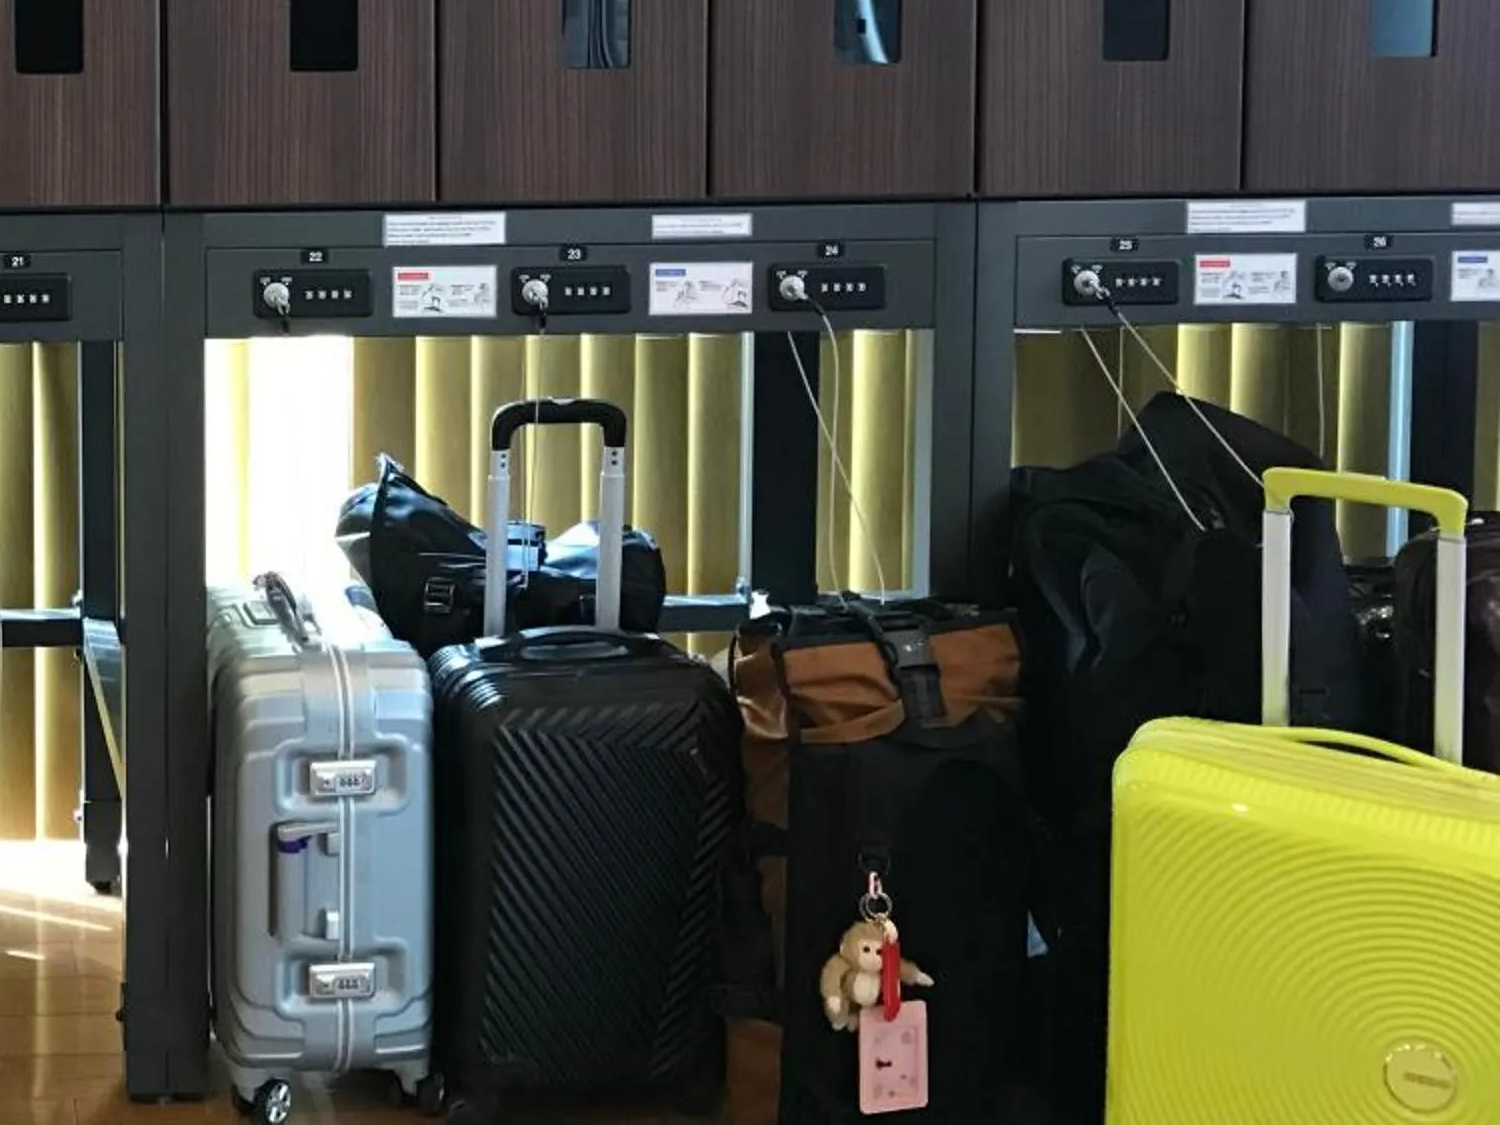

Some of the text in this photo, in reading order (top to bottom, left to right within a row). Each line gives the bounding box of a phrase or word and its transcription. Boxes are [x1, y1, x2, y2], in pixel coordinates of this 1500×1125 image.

[567, 248, 581, 260] 23
[825, 245, 839, 256] 24
[12, 256, 25, 267] 21
[309, 251, 323, 262] 22
